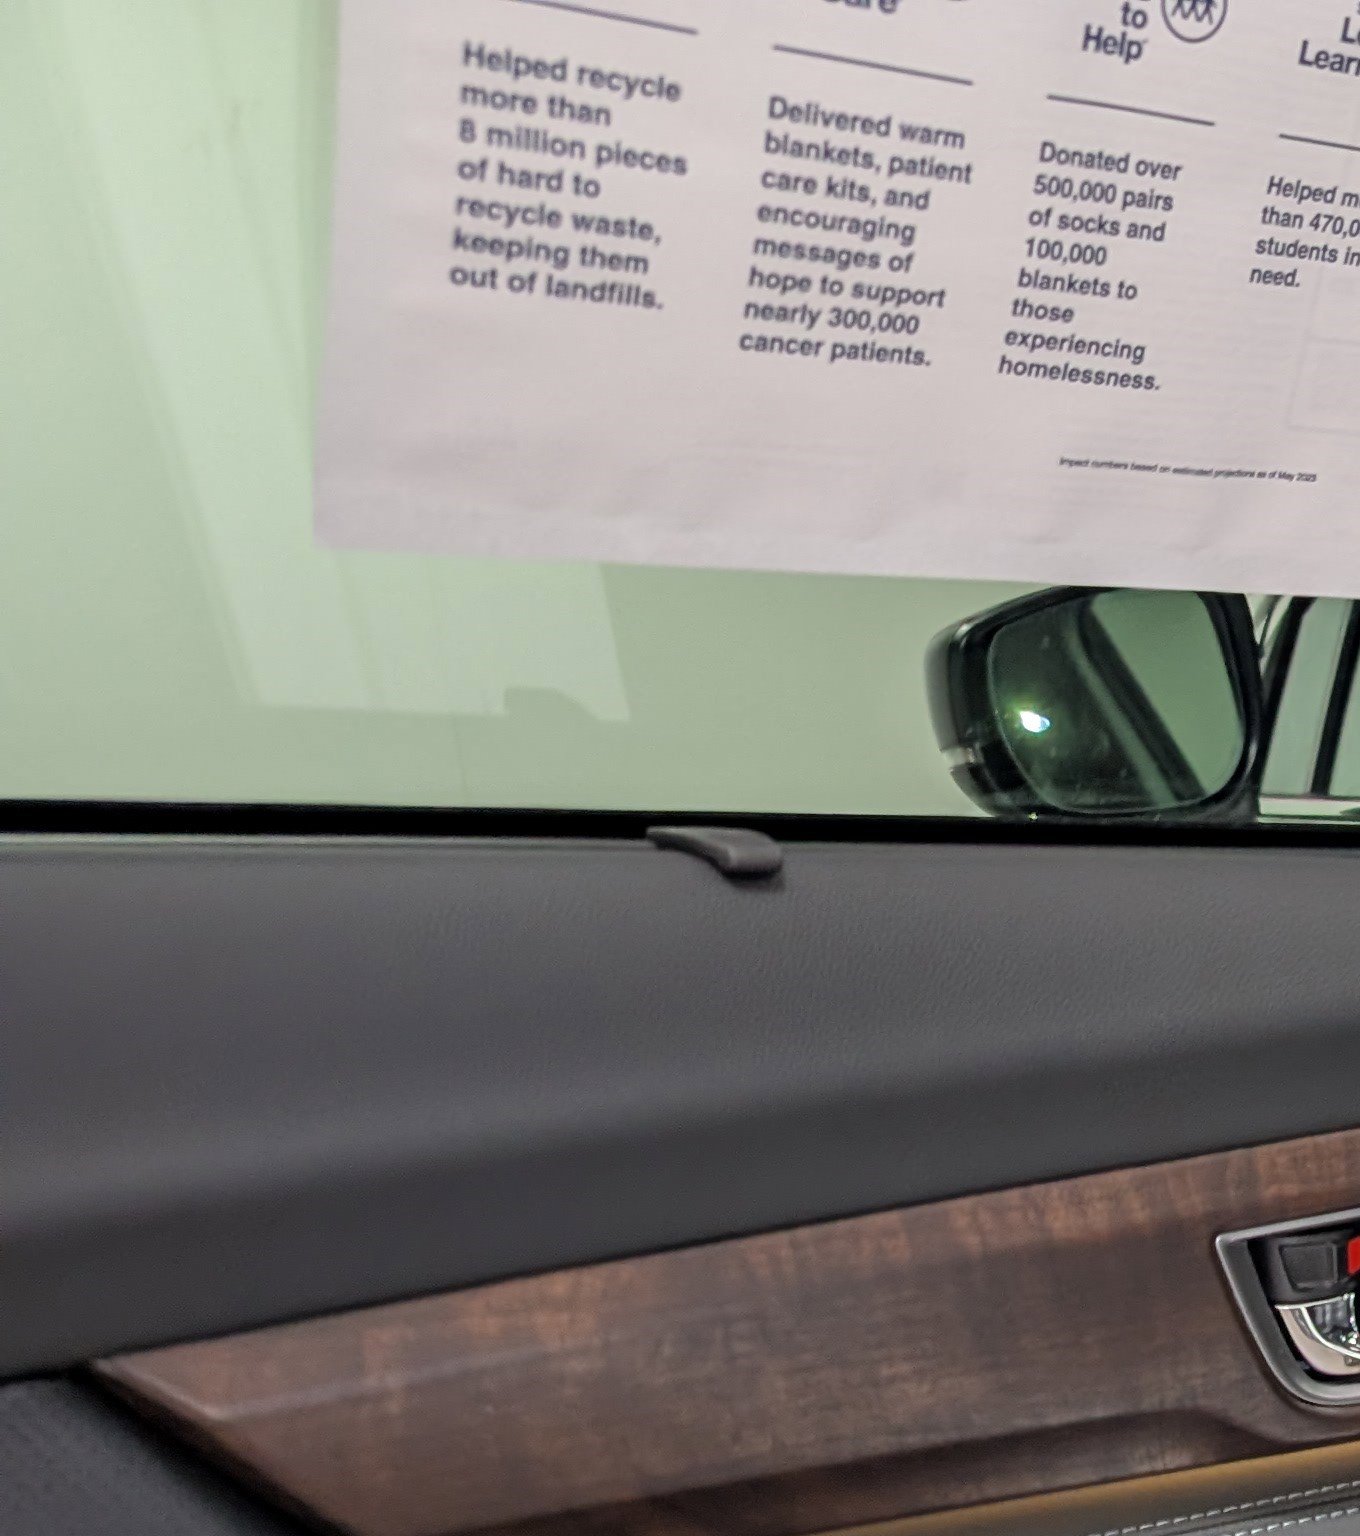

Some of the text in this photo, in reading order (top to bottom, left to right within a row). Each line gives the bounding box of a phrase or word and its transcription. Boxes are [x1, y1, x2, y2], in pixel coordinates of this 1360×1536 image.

[1121, 4, 1148, 30] to
[462, 40, 682, 103] Helped recycle
[460, 84, 611, 127] more than
[767, 95, 966, 150] Delivered warm
[458, 117, 688, 176] 8 million pieces
[763, 129, 973, 185] blankets, patient
[1038, 140, 1184, 182] Donated over
[456, 157, 601, 199] of hard to
[760, 170, 932, 212] care kits, and
[1032, 173, 1174, 213] 500,000 pairs
[1266, 175, 1339, 206] Helped
[455, 196, 661, 246] recycle waste,
[756, 204, 916, 248] encouraging
[1027, 206, 1167, 243] of socks and
[1260, 205, 1305, 230] than
[452, 227, 649, 275] keeping them
[752, 237, 915, 274] messages of
[1025, 236, 1108, 267] 100,000
[1254, 236, 1339, 264] students
[448, 266, 663, 310] out of landfills.
[747, 265, 947, 309] hope to support
[1016, 266, 1138, 301] blankets to
[1248, 267, 1301, 288] need.
[743, 301, 921, 336] nearly 300,000
[1011, 297, 1075, 324] those
[738, 333, 931, 367] cancer patients.
[1004, 330, 1147, 366] experiencing
[997, 354, 1161, 391] homelessness.
